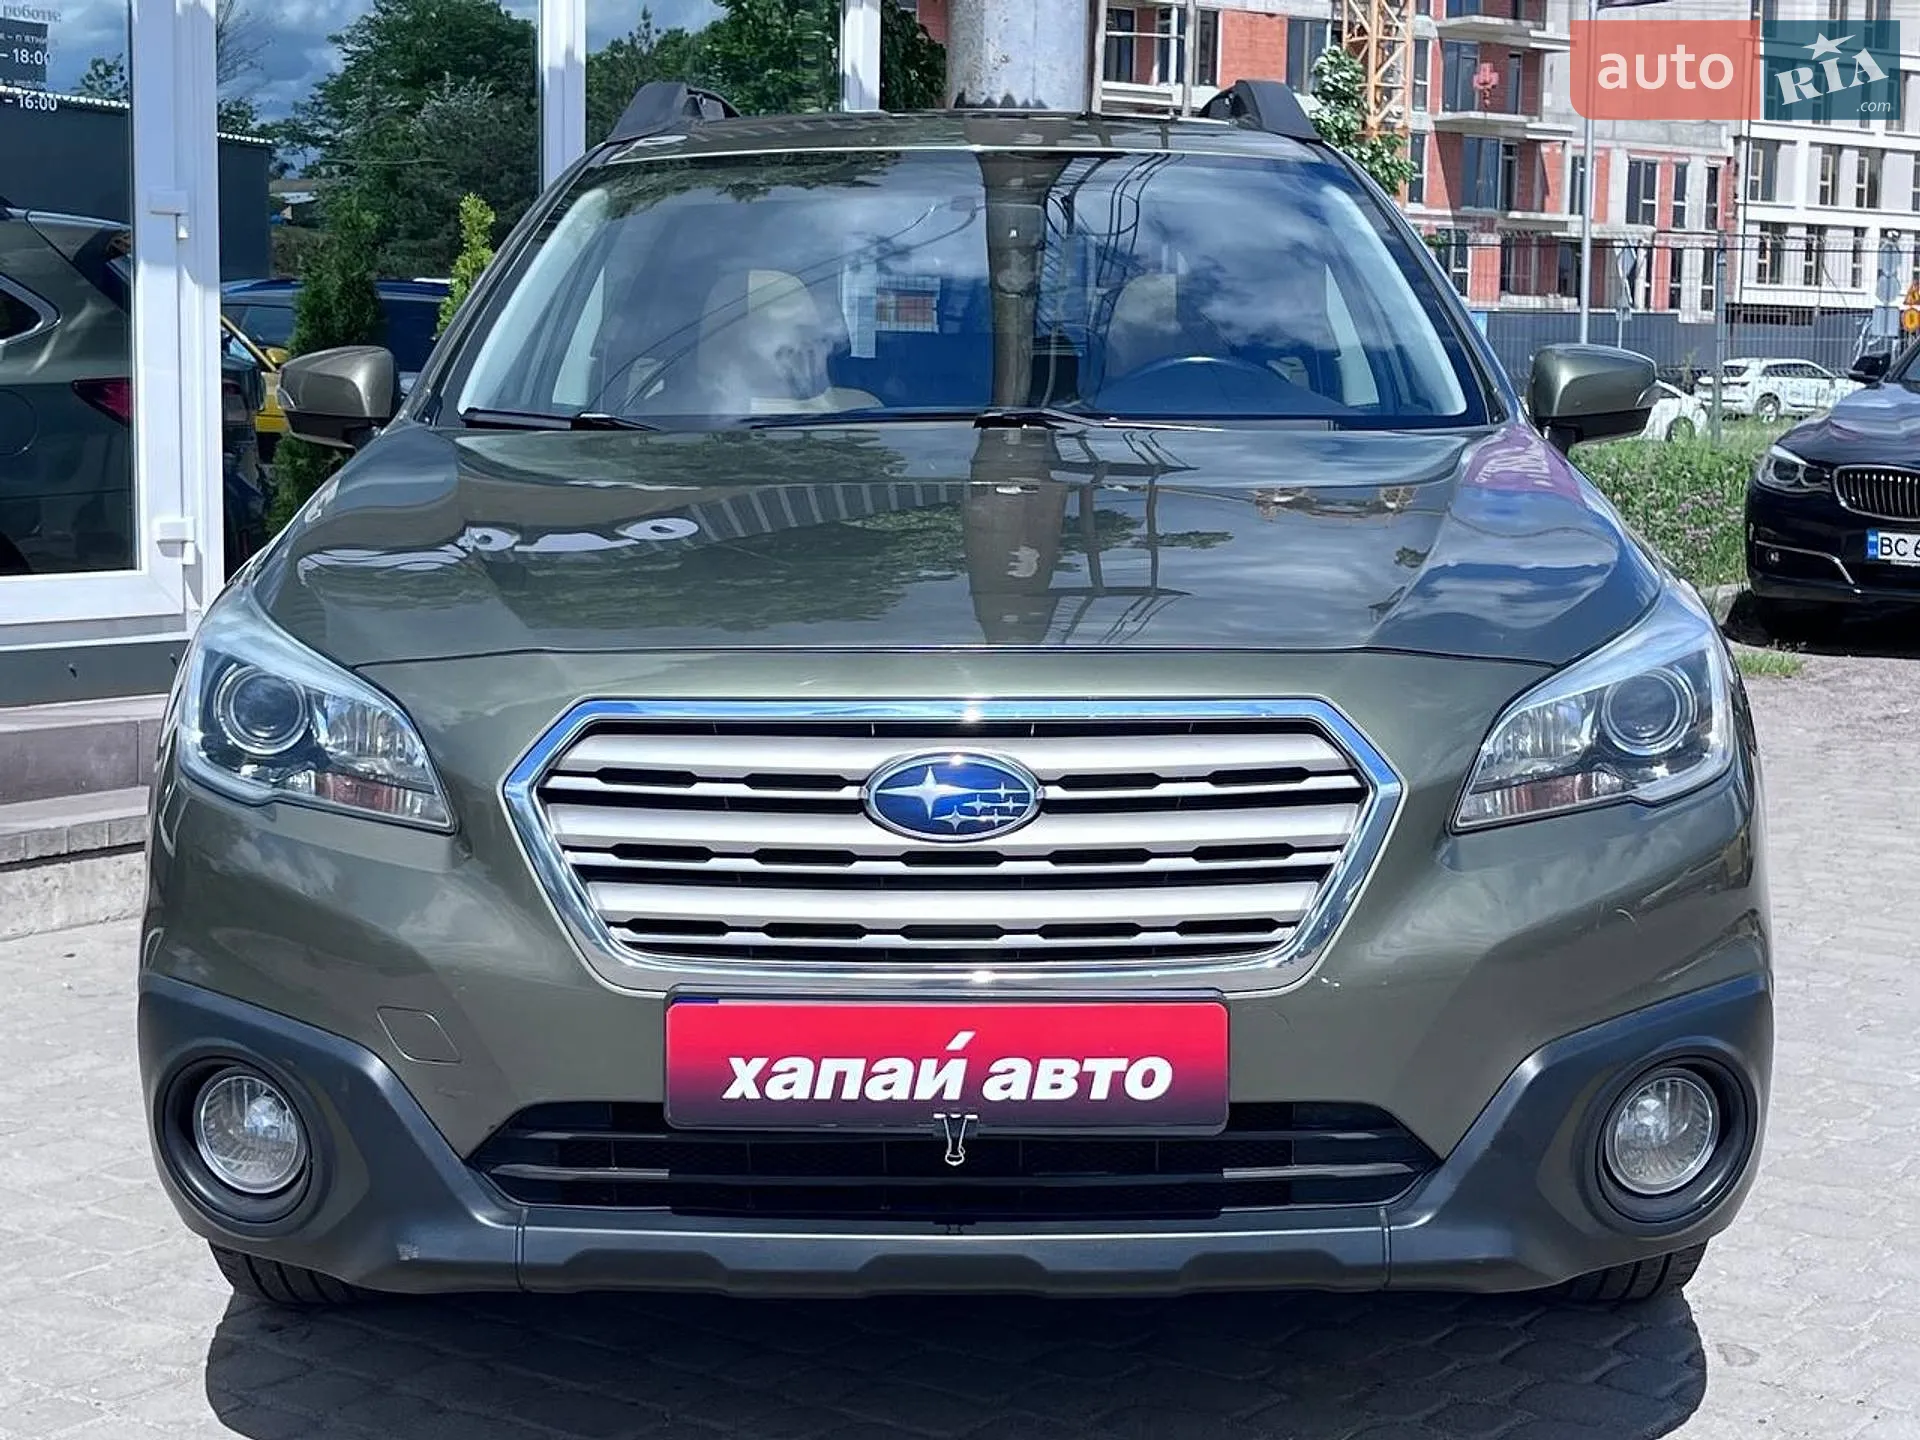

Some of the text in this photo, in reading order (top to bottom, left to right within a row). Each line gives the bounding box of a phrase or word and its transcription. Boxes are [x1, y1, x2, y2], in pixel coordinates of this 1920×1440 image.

[17, 94, 57, 111] 16:00
[1880, 537, 1908, 556] BC
[982, 1056, 1173, 1102] авто
